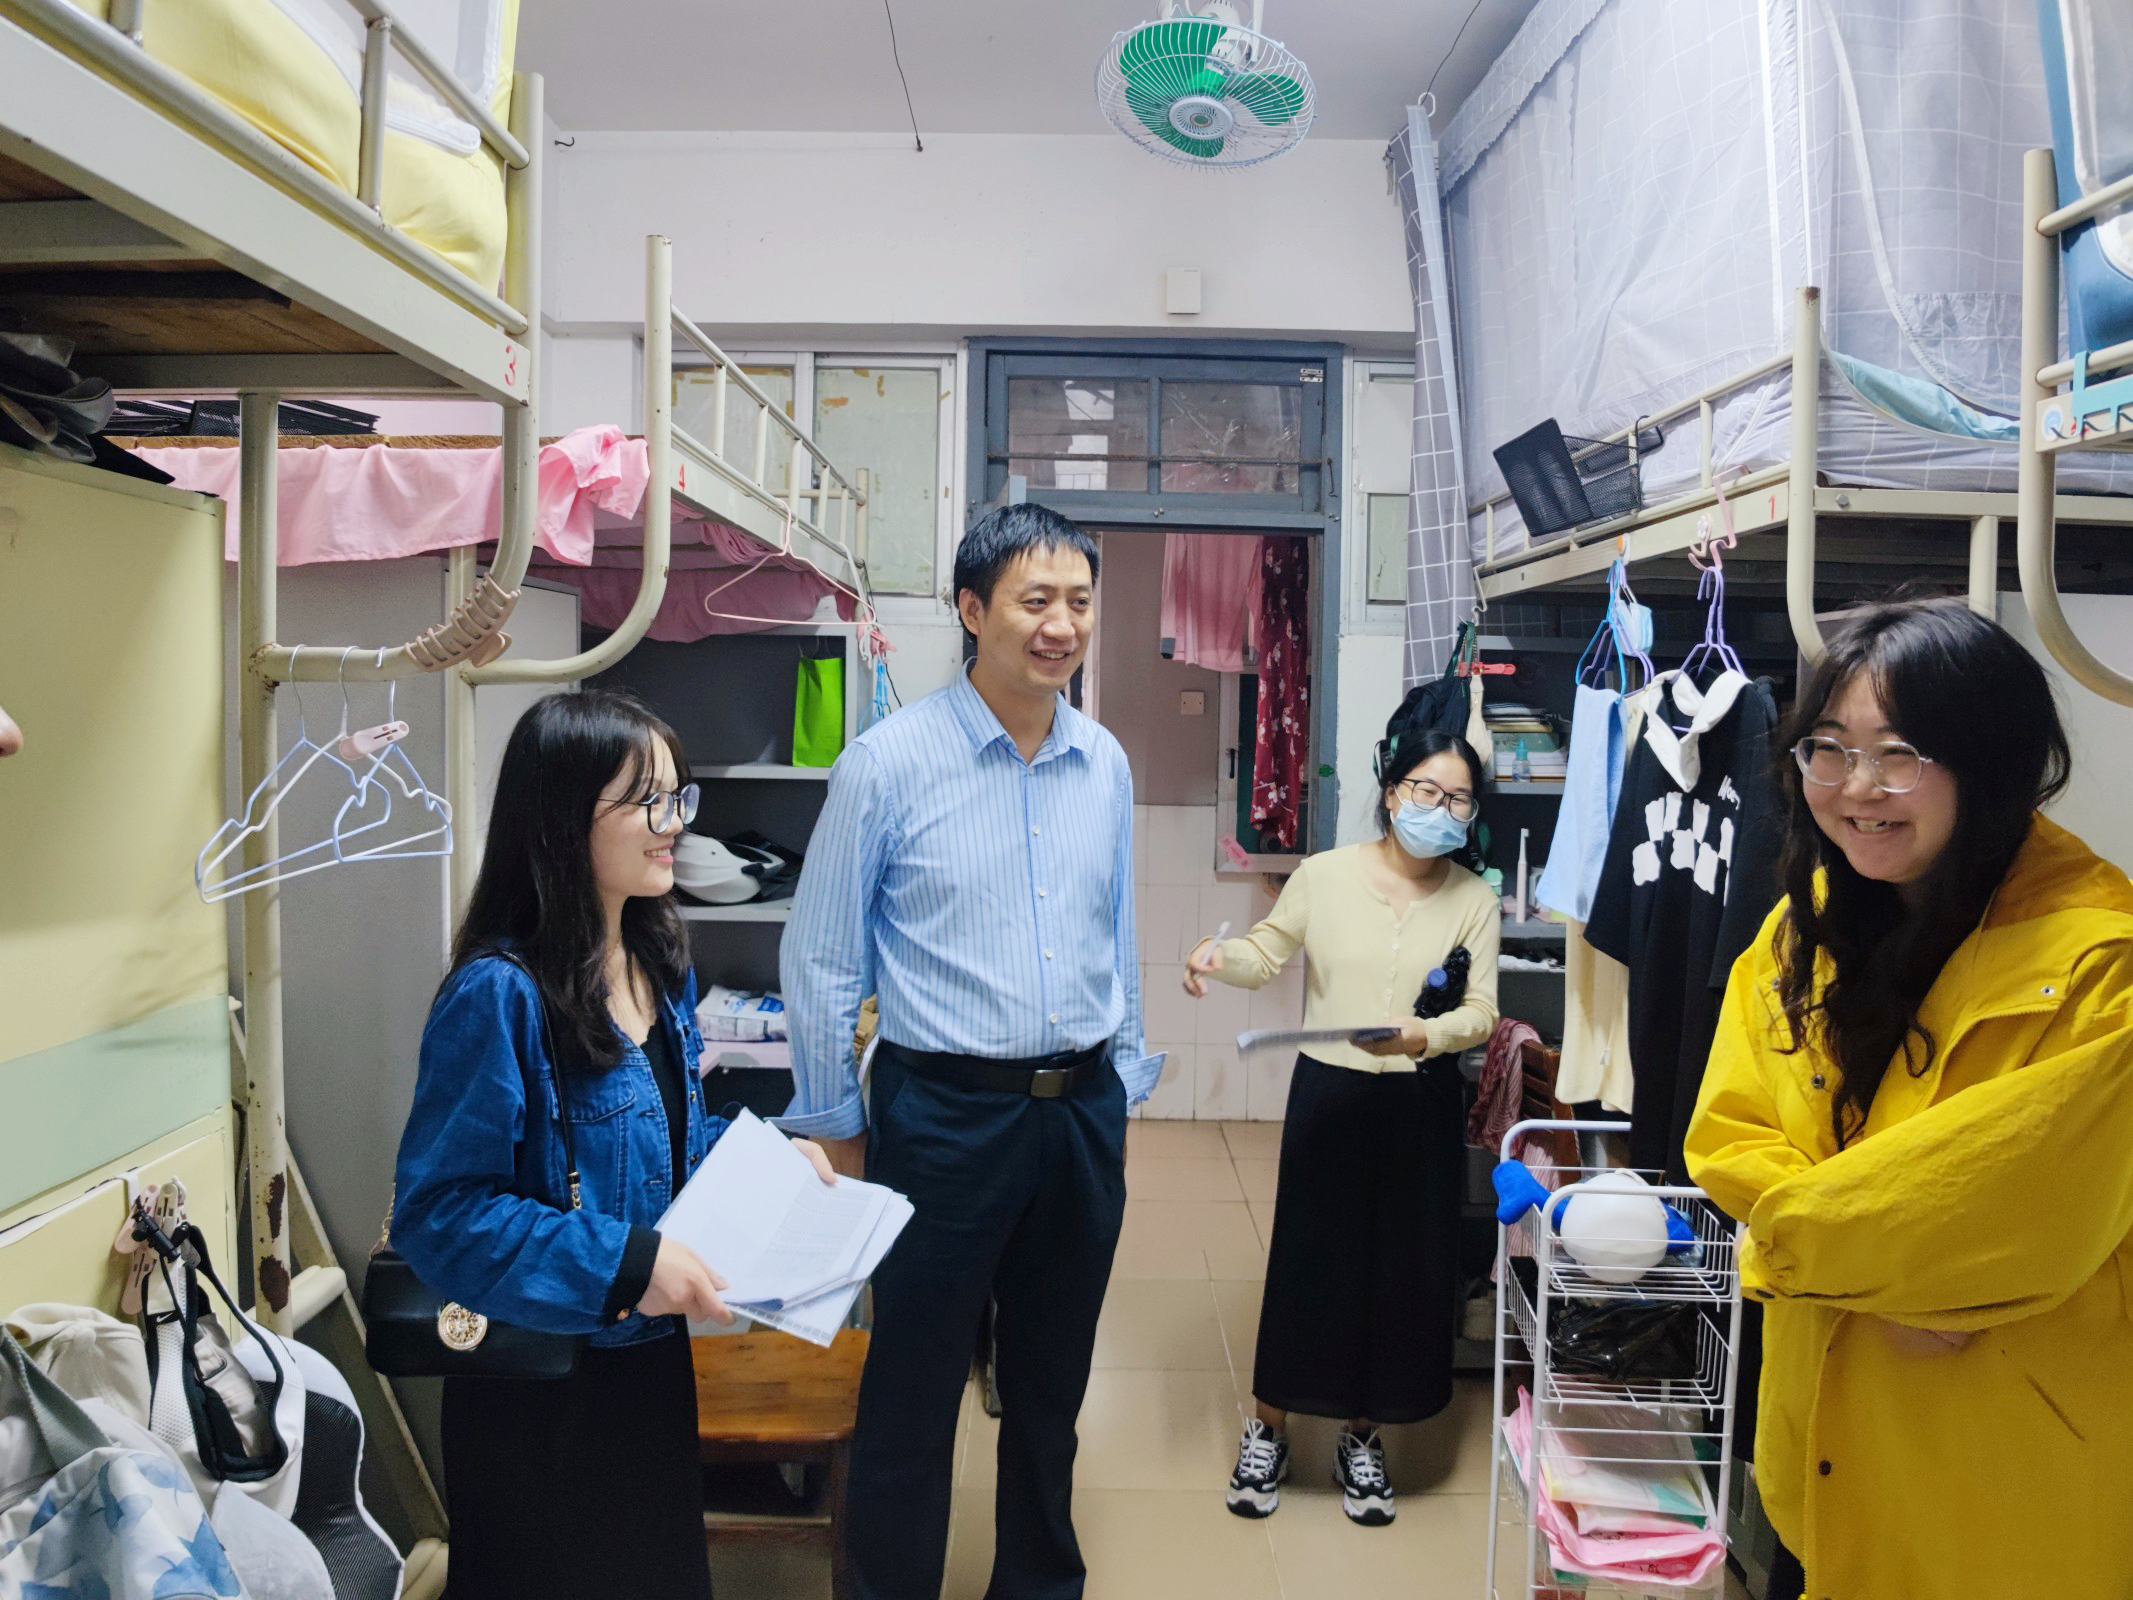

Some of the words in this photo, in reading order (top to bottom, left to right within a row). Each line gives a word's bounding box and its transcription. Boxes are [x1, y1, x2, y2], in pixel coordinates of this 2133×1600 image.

[504, 345, 517, 387] 3
[678, 463, 686, 493] 4
[1767, 495, 1776, 522] 1
